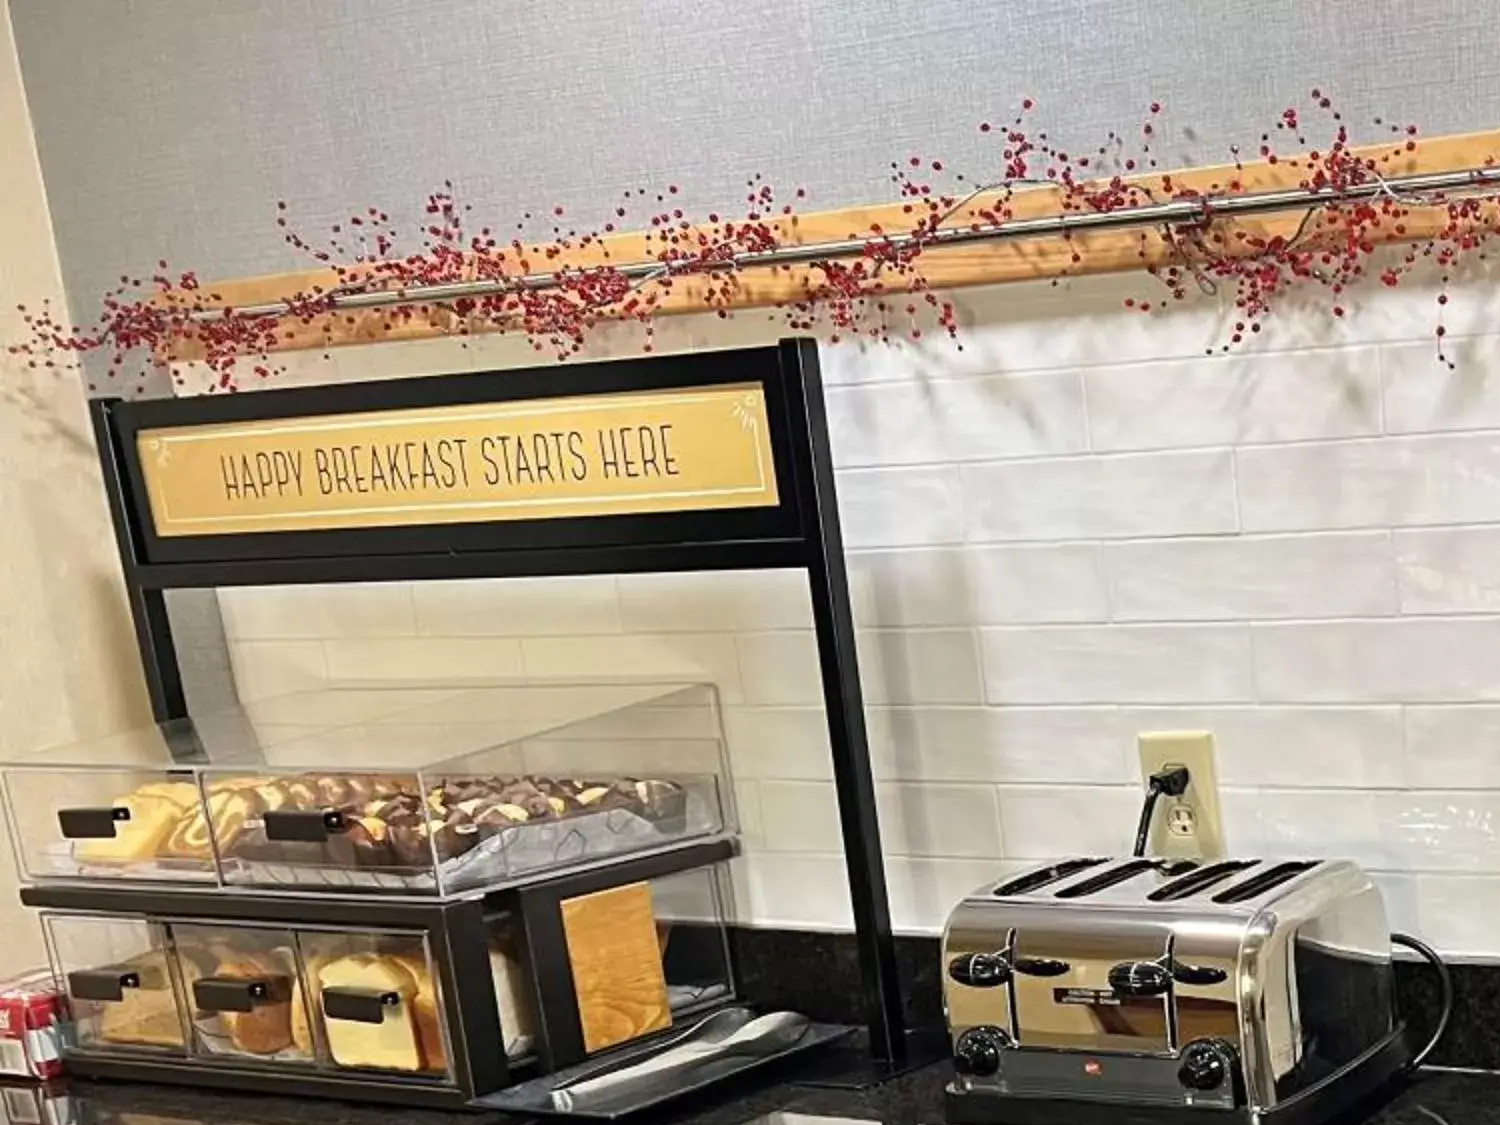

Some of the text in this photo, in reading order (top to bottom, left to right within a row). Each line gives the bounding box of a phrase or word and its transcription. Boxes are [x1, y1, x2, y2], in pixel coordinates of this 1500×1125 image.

[220, 424, 680, 501] HAPPY BREAKFAST STARTS HERE
